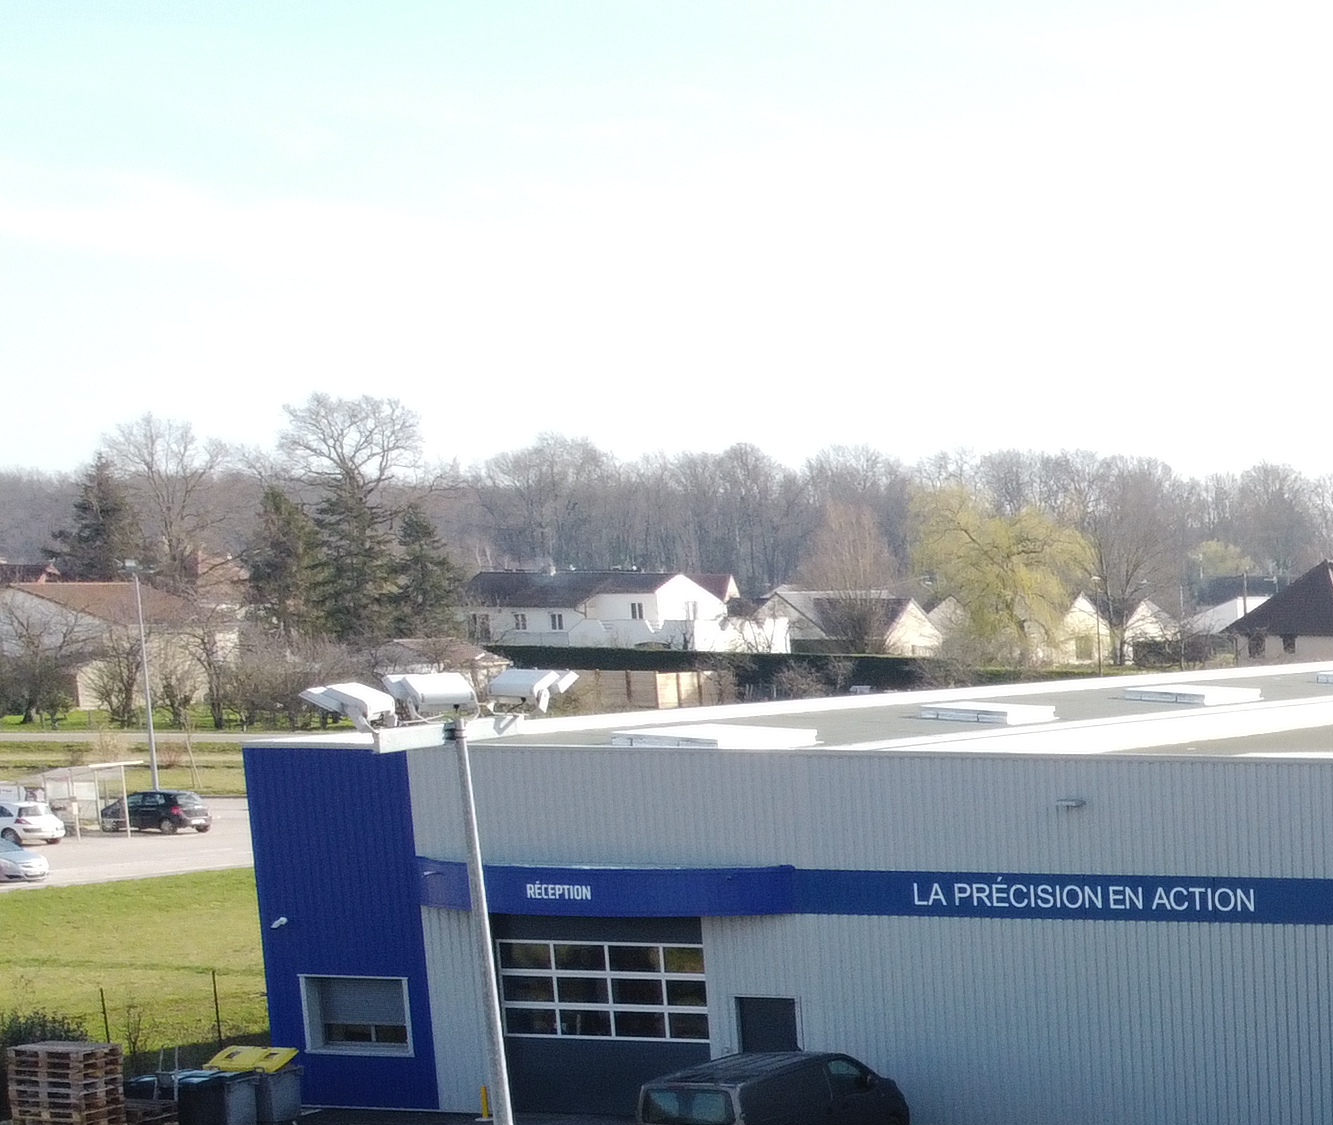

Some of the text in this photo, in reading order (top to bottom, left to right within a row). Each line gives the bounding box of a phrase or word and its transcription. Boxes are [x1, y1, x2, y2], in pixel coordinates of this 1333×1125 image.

[526, 881, 592, 900] RÉCEPTION
[913, 876, 1256, 912] LA PRÉCISION EN ACTION
